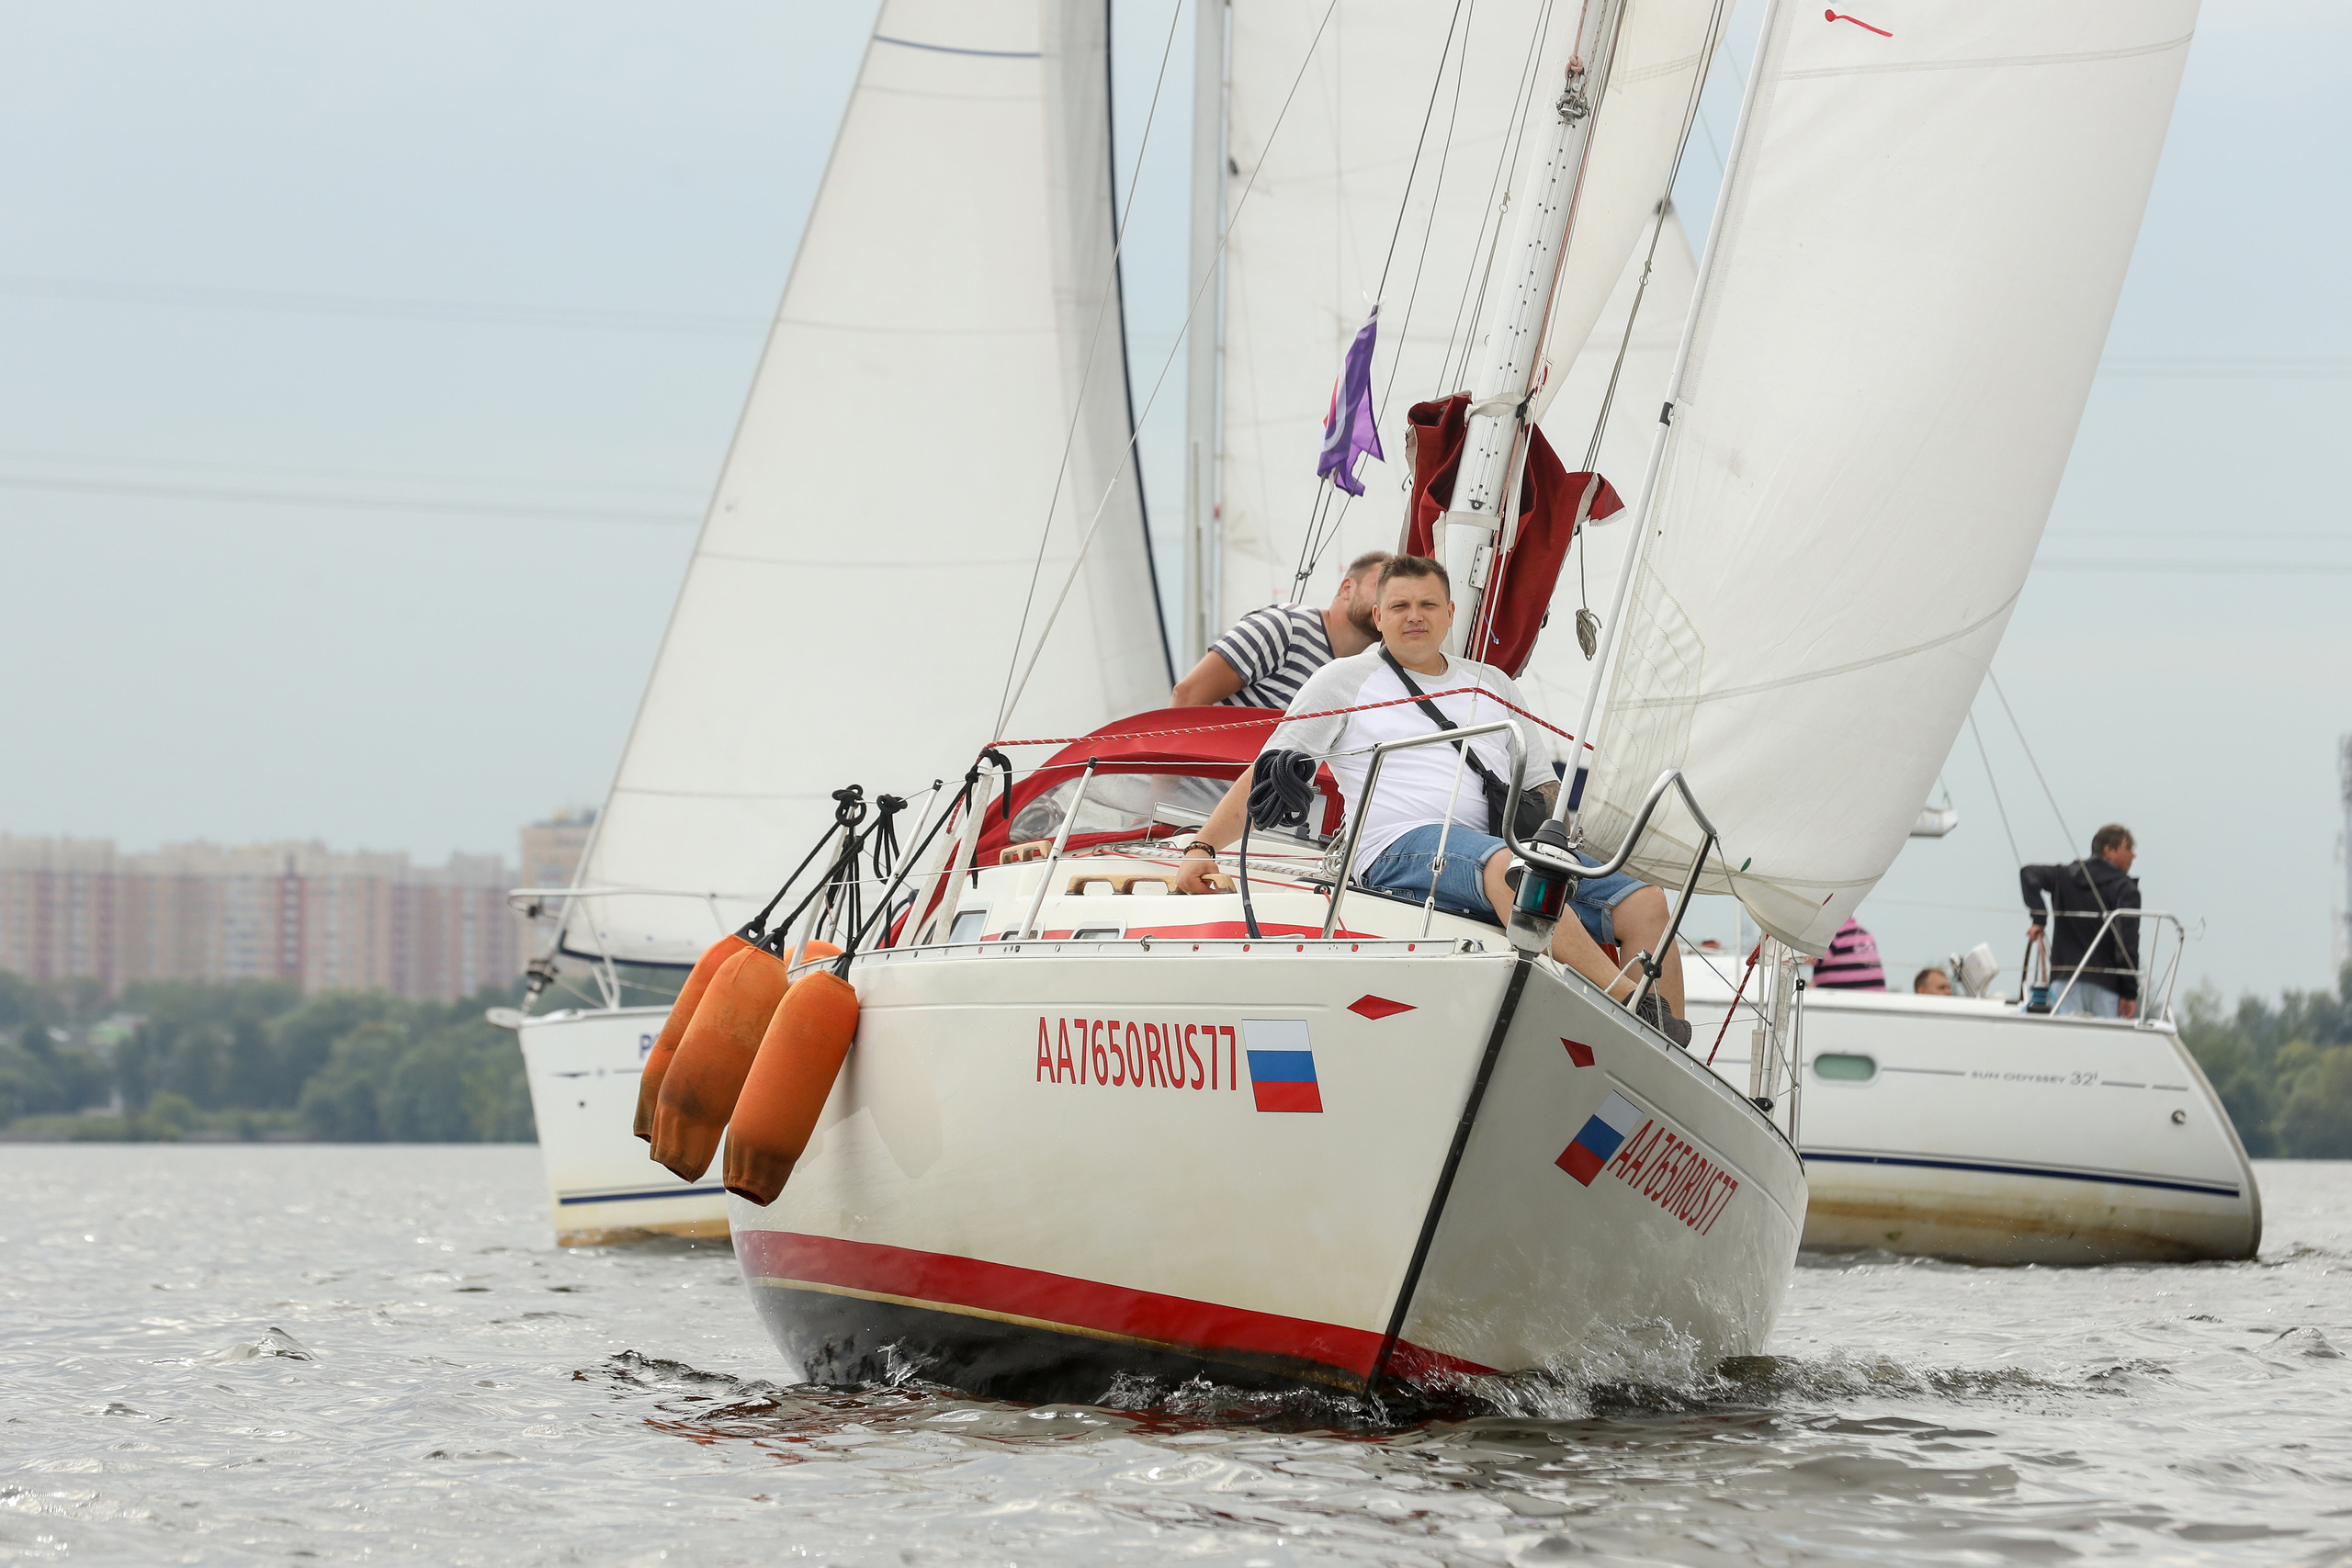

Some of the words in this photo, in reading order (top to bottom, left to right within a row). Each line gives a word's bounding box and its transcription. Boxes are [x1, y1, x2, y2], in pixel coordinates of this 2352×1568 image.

[1036, 1016, 1237, 1090] AA7650RUS77
[1971, 1070, 2000, 1080] SUN
[2003, 1072, 2067, 1084] ODYSSEY
[1606, 1119, 1739, 1236] AA7650RUS77
